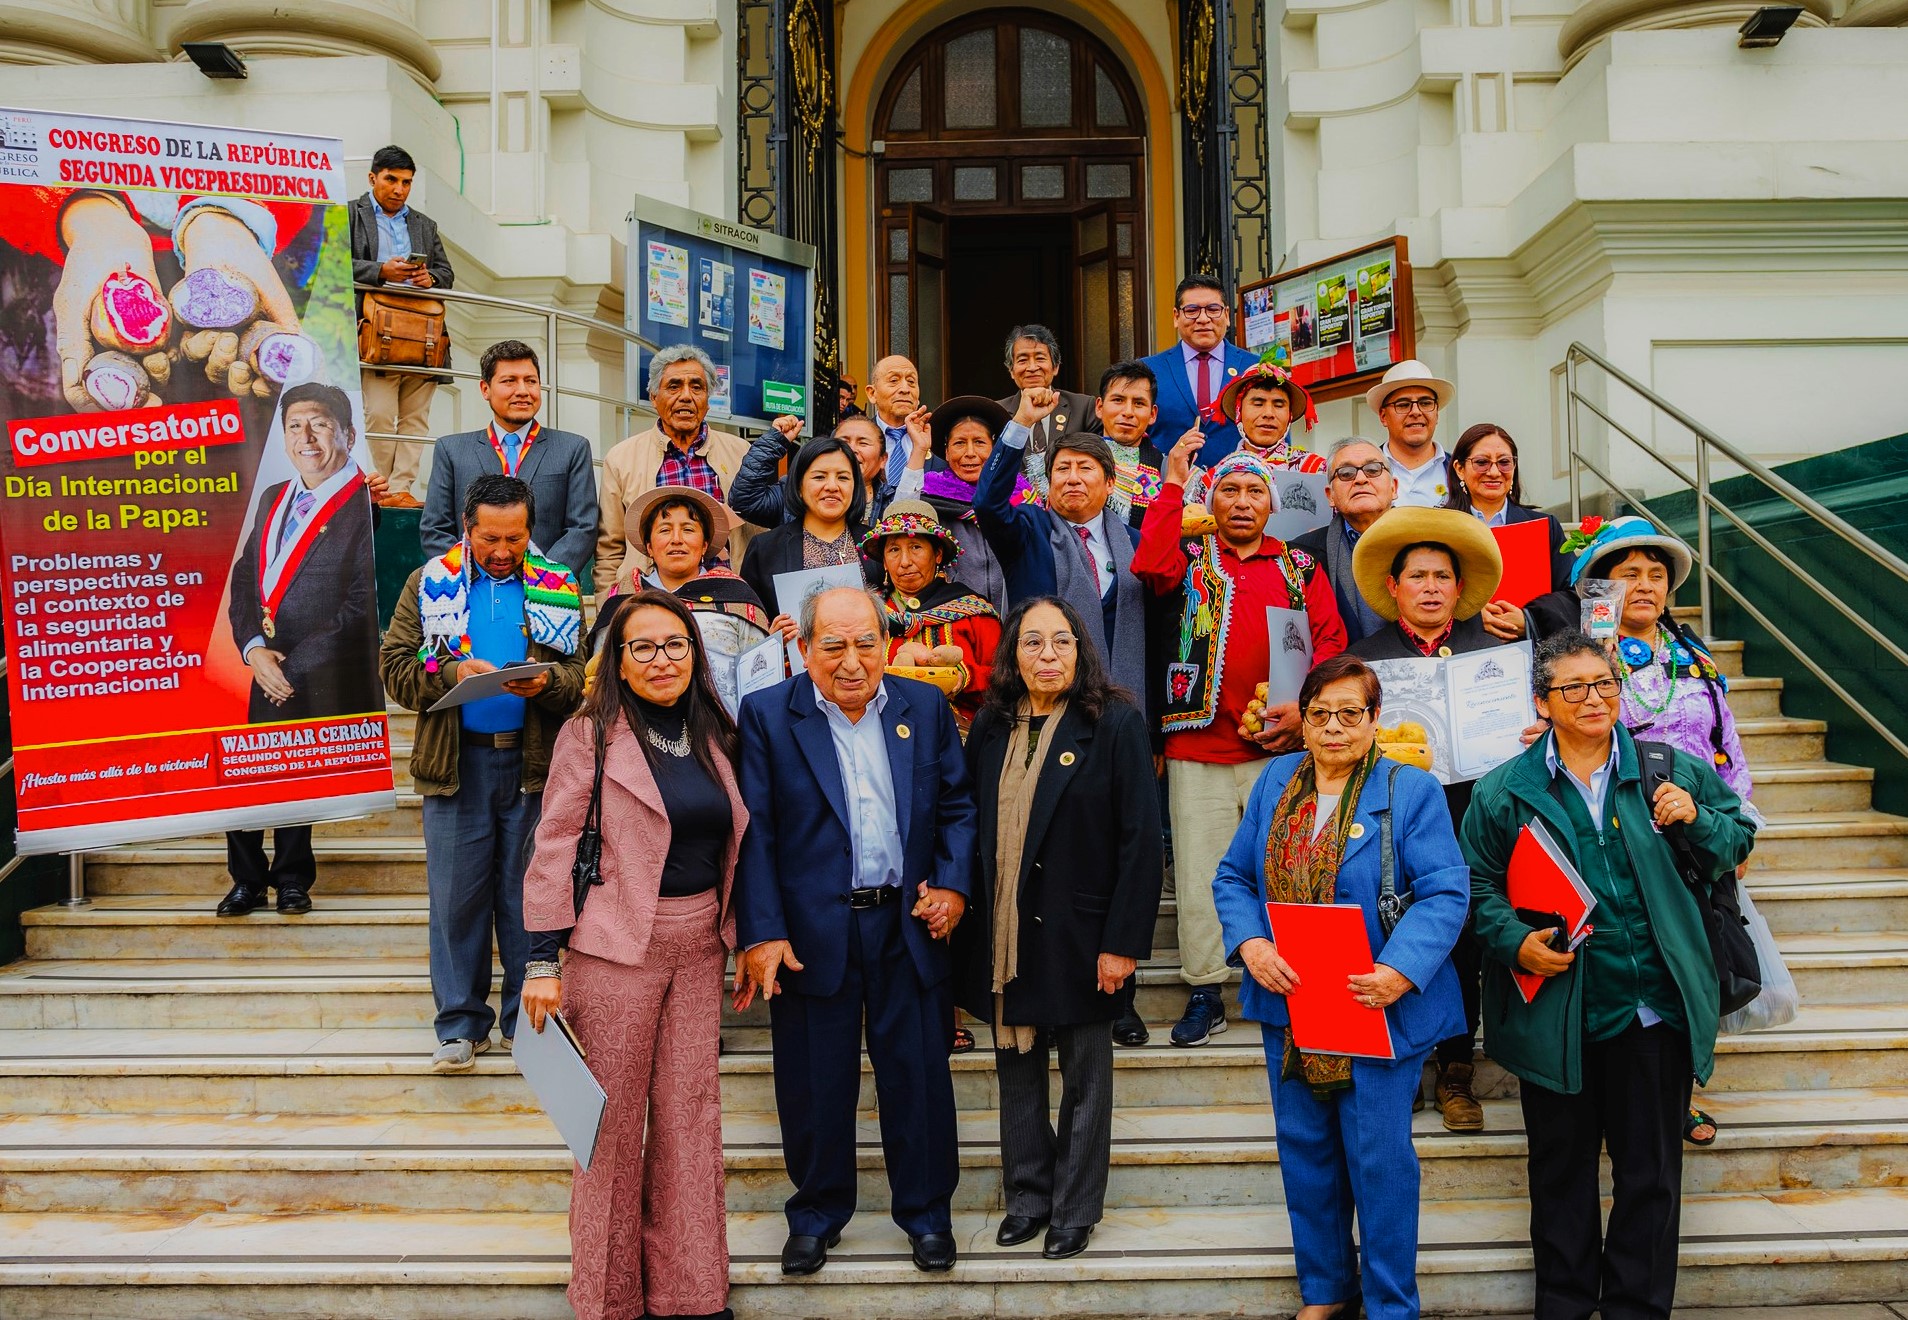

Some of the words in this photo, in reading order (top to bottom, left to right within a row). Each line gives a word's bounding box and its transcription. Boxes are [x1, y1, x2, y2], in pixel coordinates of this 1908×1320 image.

[48, 128, 161, 156] CONGRESO
[165, 138, 193, 158] DE
[196, 140, 223, 161] LA
[227, 142, 332, 171] REPÚBLICA
[0, 167, 39, 177] BLICA
[60, 158, 157, 188] SEGUNDA
[159, 166, 329, 200] VICEPRESIDENCIA
[713, 222, 759, 244] SITRACON
[14, 408, 240, 456] Conversatorio
[134, 449, 178, 470] por
[184, 445, 207, 466] el
[5, 475, 52, 499] Día
[61, 472, 239, 497] Internacional
[43, 510, 78, 532] de
[86, 509, 111, 530] la
[119, 504, 209, 534] Papa:
[11, 553, 142, 573] Problemas
[148, 553, 162, 571] y
[13, 571, 169, 598] perspectivas
[174, 571, 203, 586] en
[14, 597, 37, 616] el
[44, 592, 150, 614] contexto
[156, 590, 185, 607] de
[16, 619, 38, 637] la
[45, 611, 167, 637] seguridad
[18, 633, 154, 659] alimentaria
[159, 635, 173, 652] y
[20, 662, 42, 680] la
[49, 650, 202, 678] Cooperación
[22, 672, 180, 702] Internacional
[220, 728, 316, 753] WALDEMAR
[318, 718, 384, 744] CERRÓN
[222, 751, 282, 765] SEGUNDO
[284, 740, 385, 759] VICEPRESIDENTE
[224, 763, 287, 777] CONGRESO
[289, 761, 305, 771] DE
[307, 759, 322, 769] LA
[324, 752, 387, 767] REPÚBLICA
[19, 772, 67, 796] ¡Hasta
[69, 769, 97, 783] más
[99, 766, 124, 779] allá
[126, 763, 142, 776] de
[144, 762, 157, 774] la
[159, 753, 210, 773] victoria!
